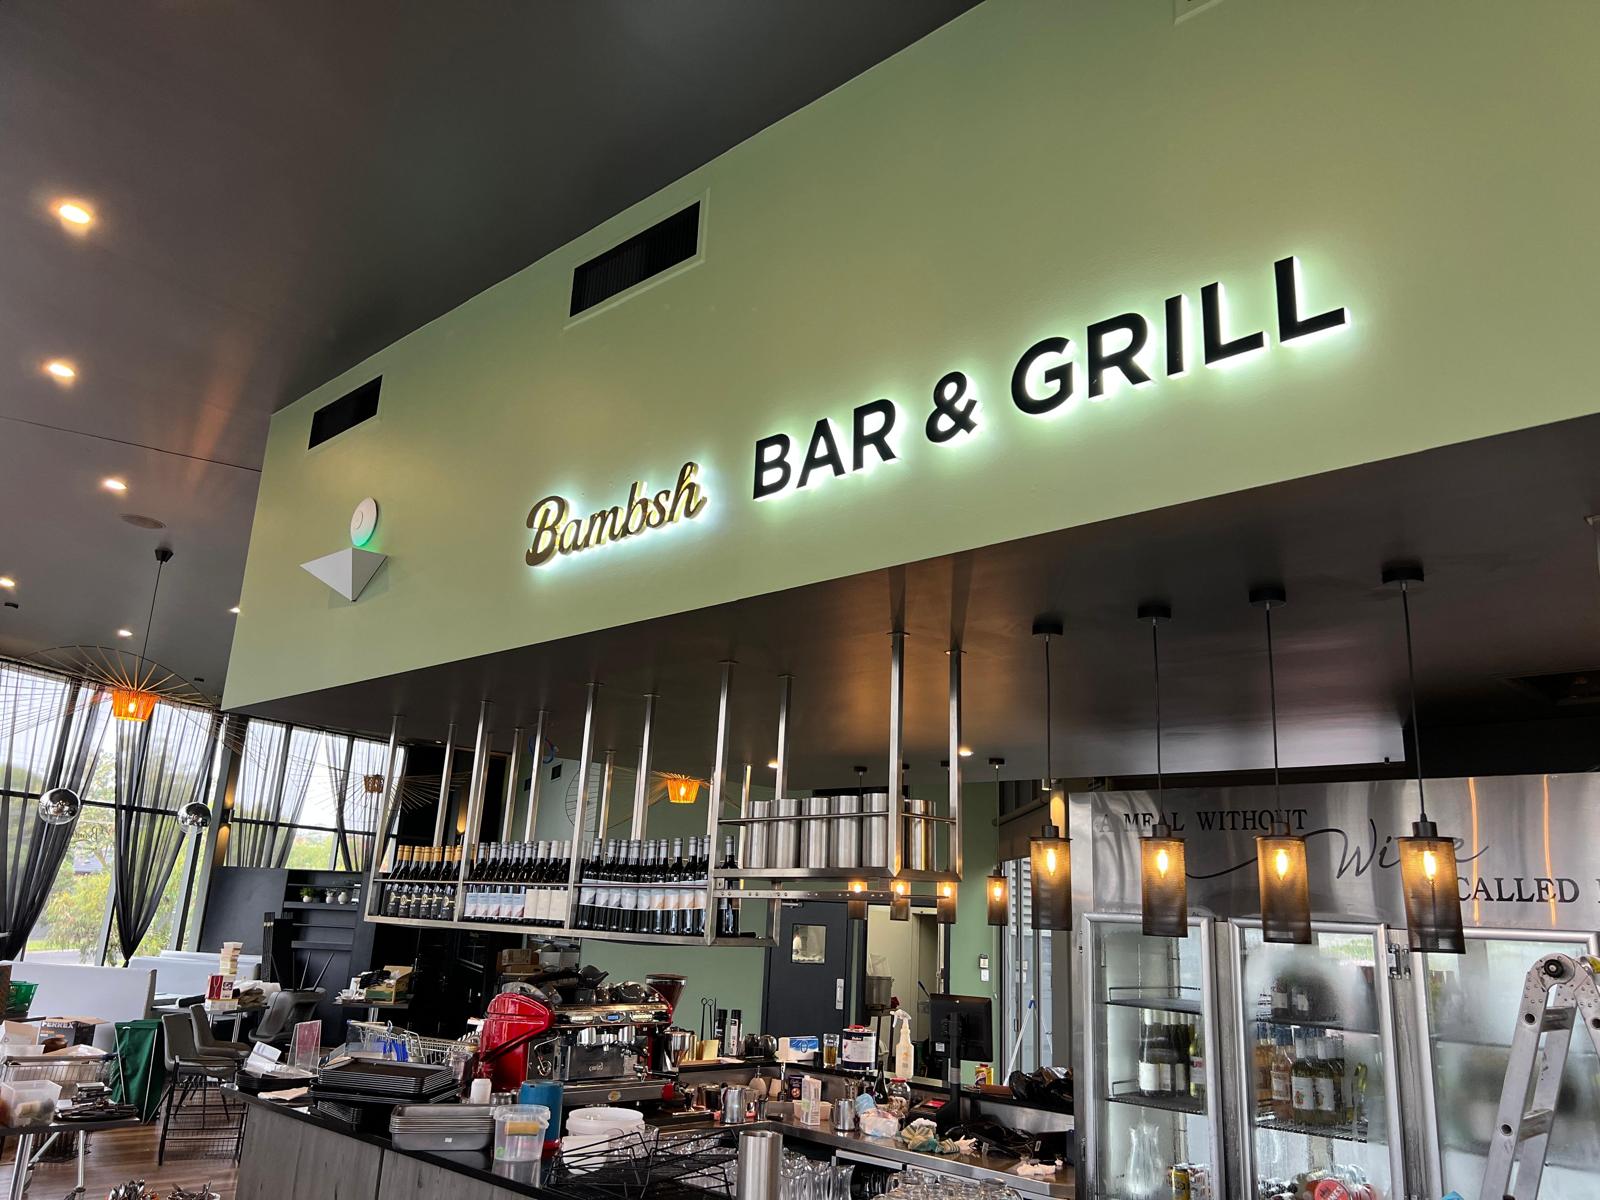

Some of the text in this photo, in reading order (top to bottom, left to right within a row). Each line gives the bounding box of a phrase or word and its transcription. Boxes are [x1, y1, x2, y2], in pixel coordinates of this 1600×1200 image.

[525, 256, 1347, 567] Bambsh BAR & GRILL
[1303, 818, 1489, 880] Wie
[1457, 877, 1580, 904] CALLED
